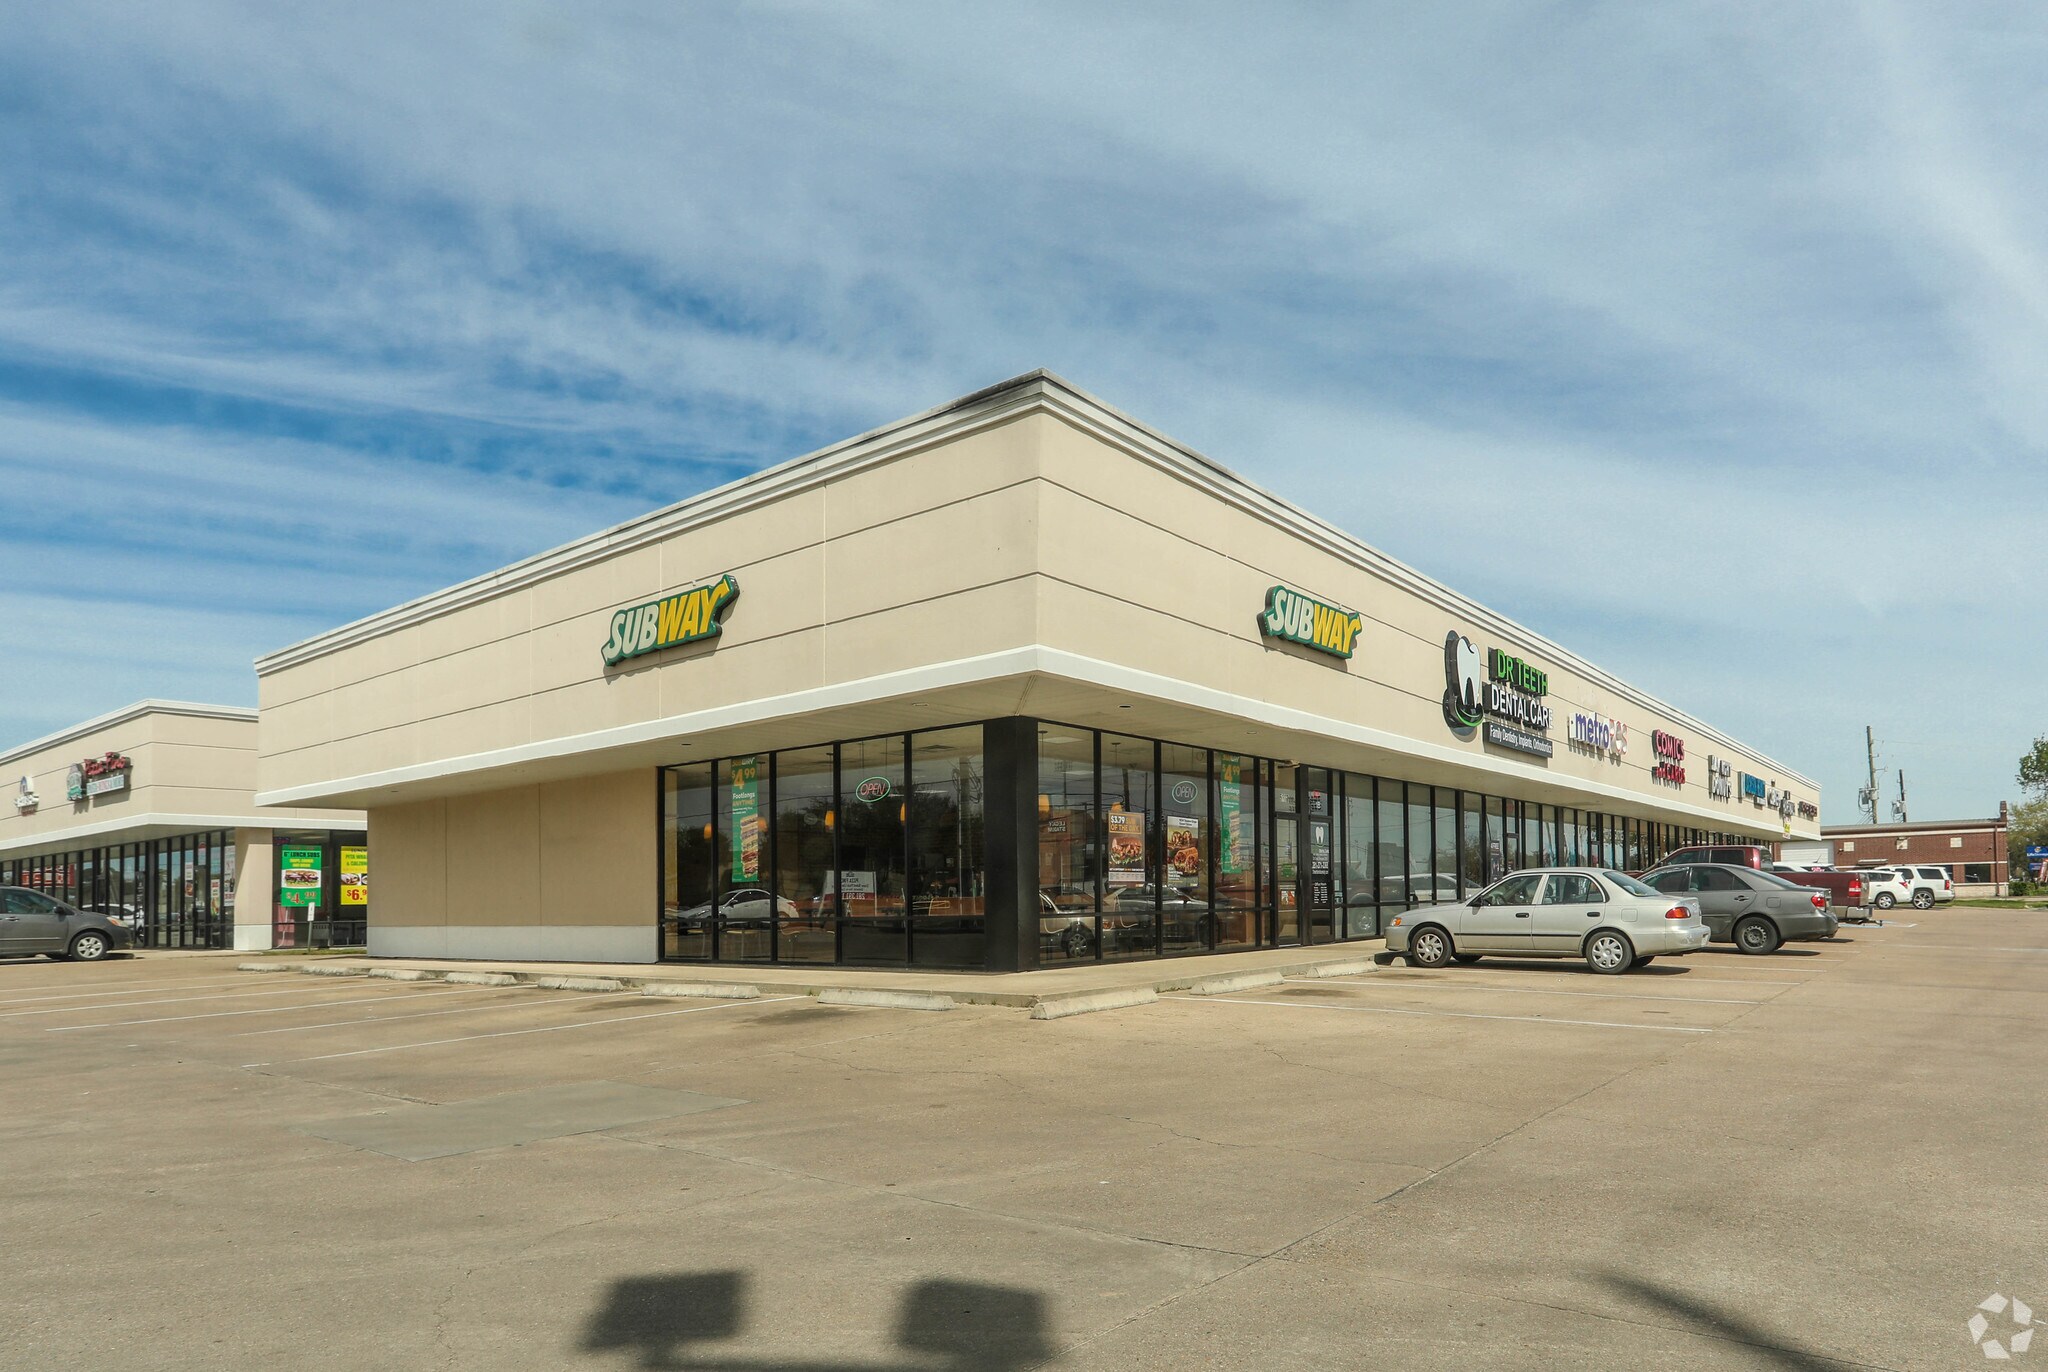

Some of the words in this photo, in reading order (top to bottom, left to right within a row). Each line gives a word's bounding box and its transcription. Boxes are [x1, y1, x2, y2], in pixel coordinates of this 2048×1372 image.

[602, 578, 731, 660] SUBWAY
[1267, 588, 1361, 654] SUBWAY
[1496, 648, 1514, 683] DR
[1515, 657, 1549, 696] TEETH
[1491, 684, 1530, 722] DENTAL
[1530, 698, 1554, 730] CARE
[1489, 725, 1503, 743] Family
[1656, 729, 1685, 761] COMICS
[732, 791, 756, 800] Footlongs
[860, 782, 886, 796] OPEN
[1175, 785, 1194, 799] OPEN
[1110, 815, 1126, 825] $3.79
